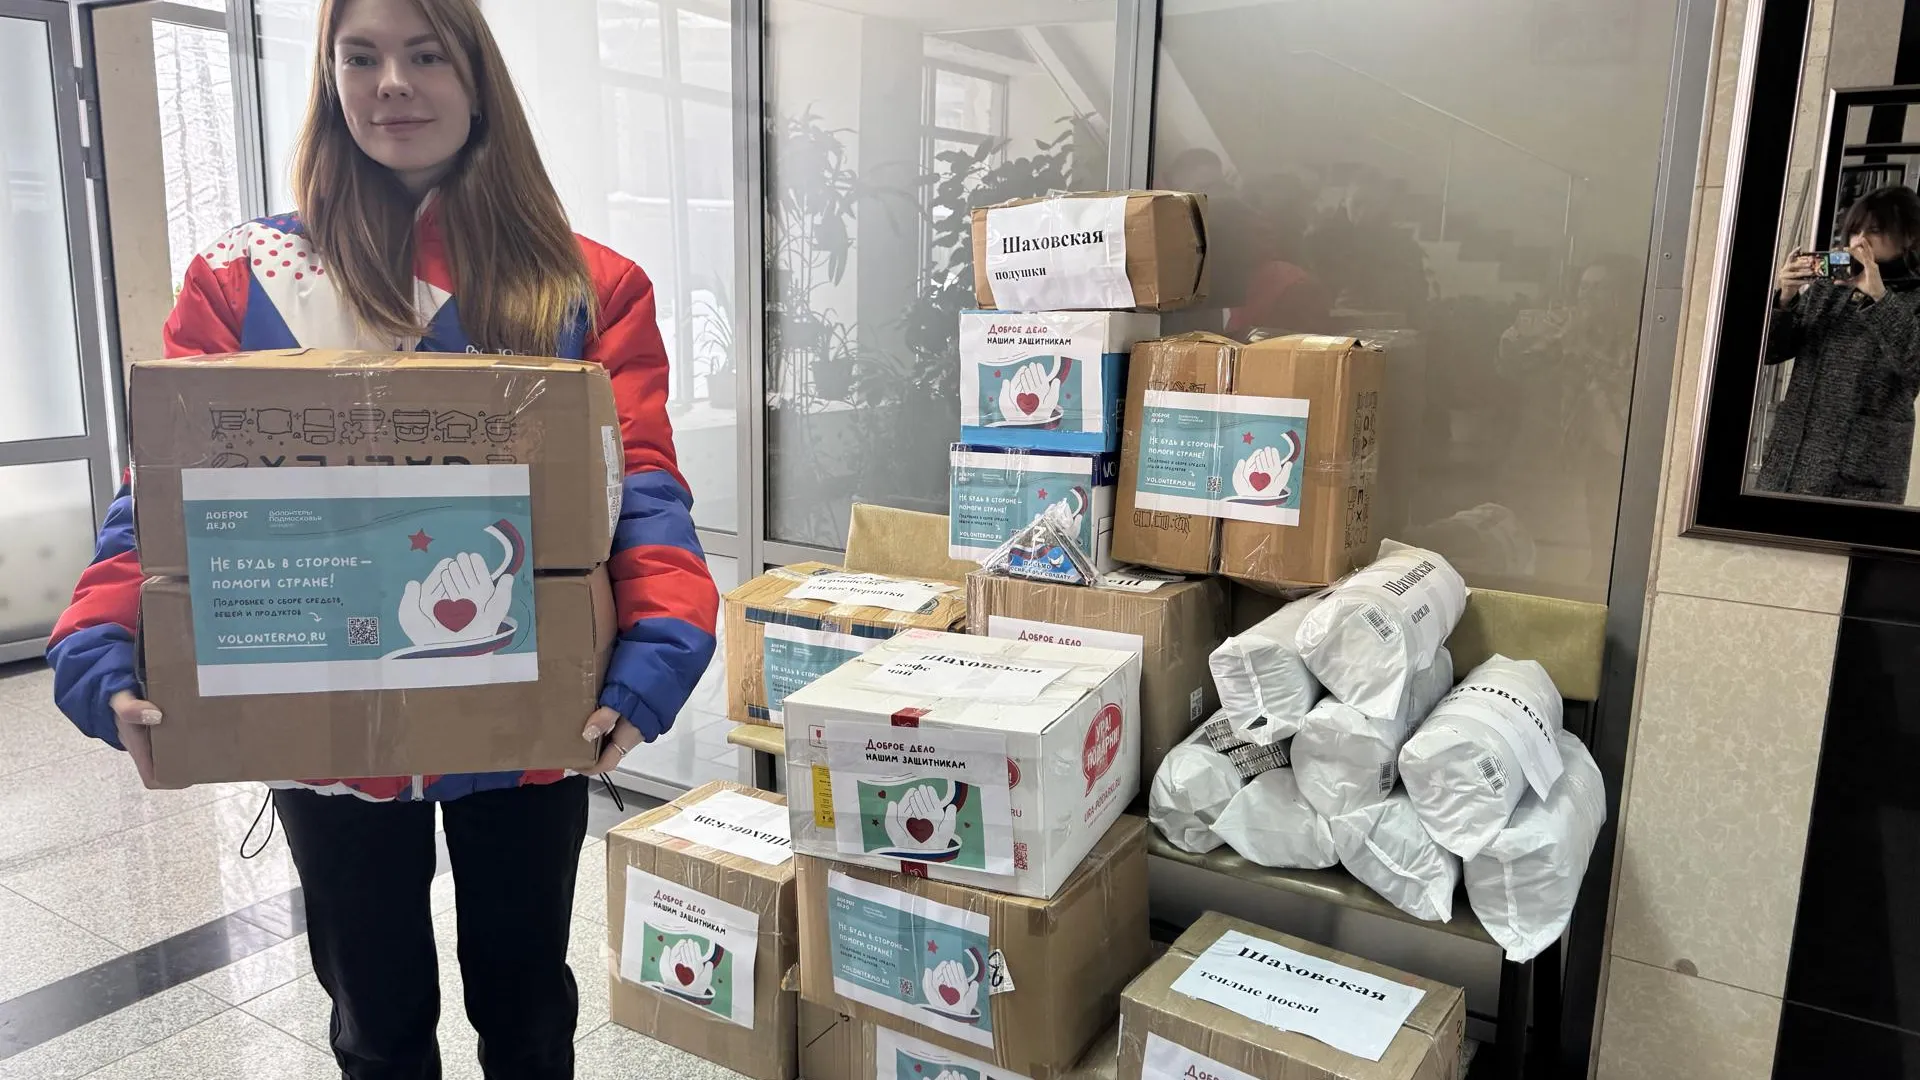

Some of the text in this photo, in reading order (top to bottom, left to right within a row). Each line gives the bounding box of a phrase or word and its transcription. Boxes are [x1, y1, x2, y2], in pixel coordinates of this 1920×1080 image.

[1002, 230, 1104, 254] Шаховская
[995, 267, 1047, 282] подушки
[987, 324, 1048, 336] ДОБРОЕ ДЕЛО
[987, 337, 1072, 346] НАШИМ ЗАЩИТНИКАМ
[206, 510, 249, 520] ДОБРОЕ
[206, 521, 236, 530] ДЕЛО
[210, 556, 231, 573] НЕ
[237, 558, 276, 570] БУДЬ
[282, 558, 290, 569] В
[296, 556, 358, 568] СТОРОНЕ
[212, 572, 335, 589] ПОМОГИ СТРАНЕ!
[1381, 560, 1437, 597] Шаховская
[213, 597, 264, 608] ПОДРОБНЕЕ
[215, 609, 243, 617] ВЕЩЕЙ
[255, 609, 302, 618] ПРОДУКТОВ
[217, 631, 327, 645] VOLONTERMO.RU
[1017, 629, 1082, 647] ДОБРОЕ ДЕЛО
[887, 668, 913, 677] чай
[865, 738, 936, 754] ДОБРОЕ ДЕЛО
[866, 752, 966, 770] НАШИМ ЗАЩИТНИКАМ
[653, 889, 706, 916] ДОБРОЕ ДЕЛО
[653, 900, 727, 936] НАШИМ ЗАЩИТНИКАМ
[1236, 946, 1387, 1002] Шаховская
[1199, 969, 1321, 1015] теплые носки
